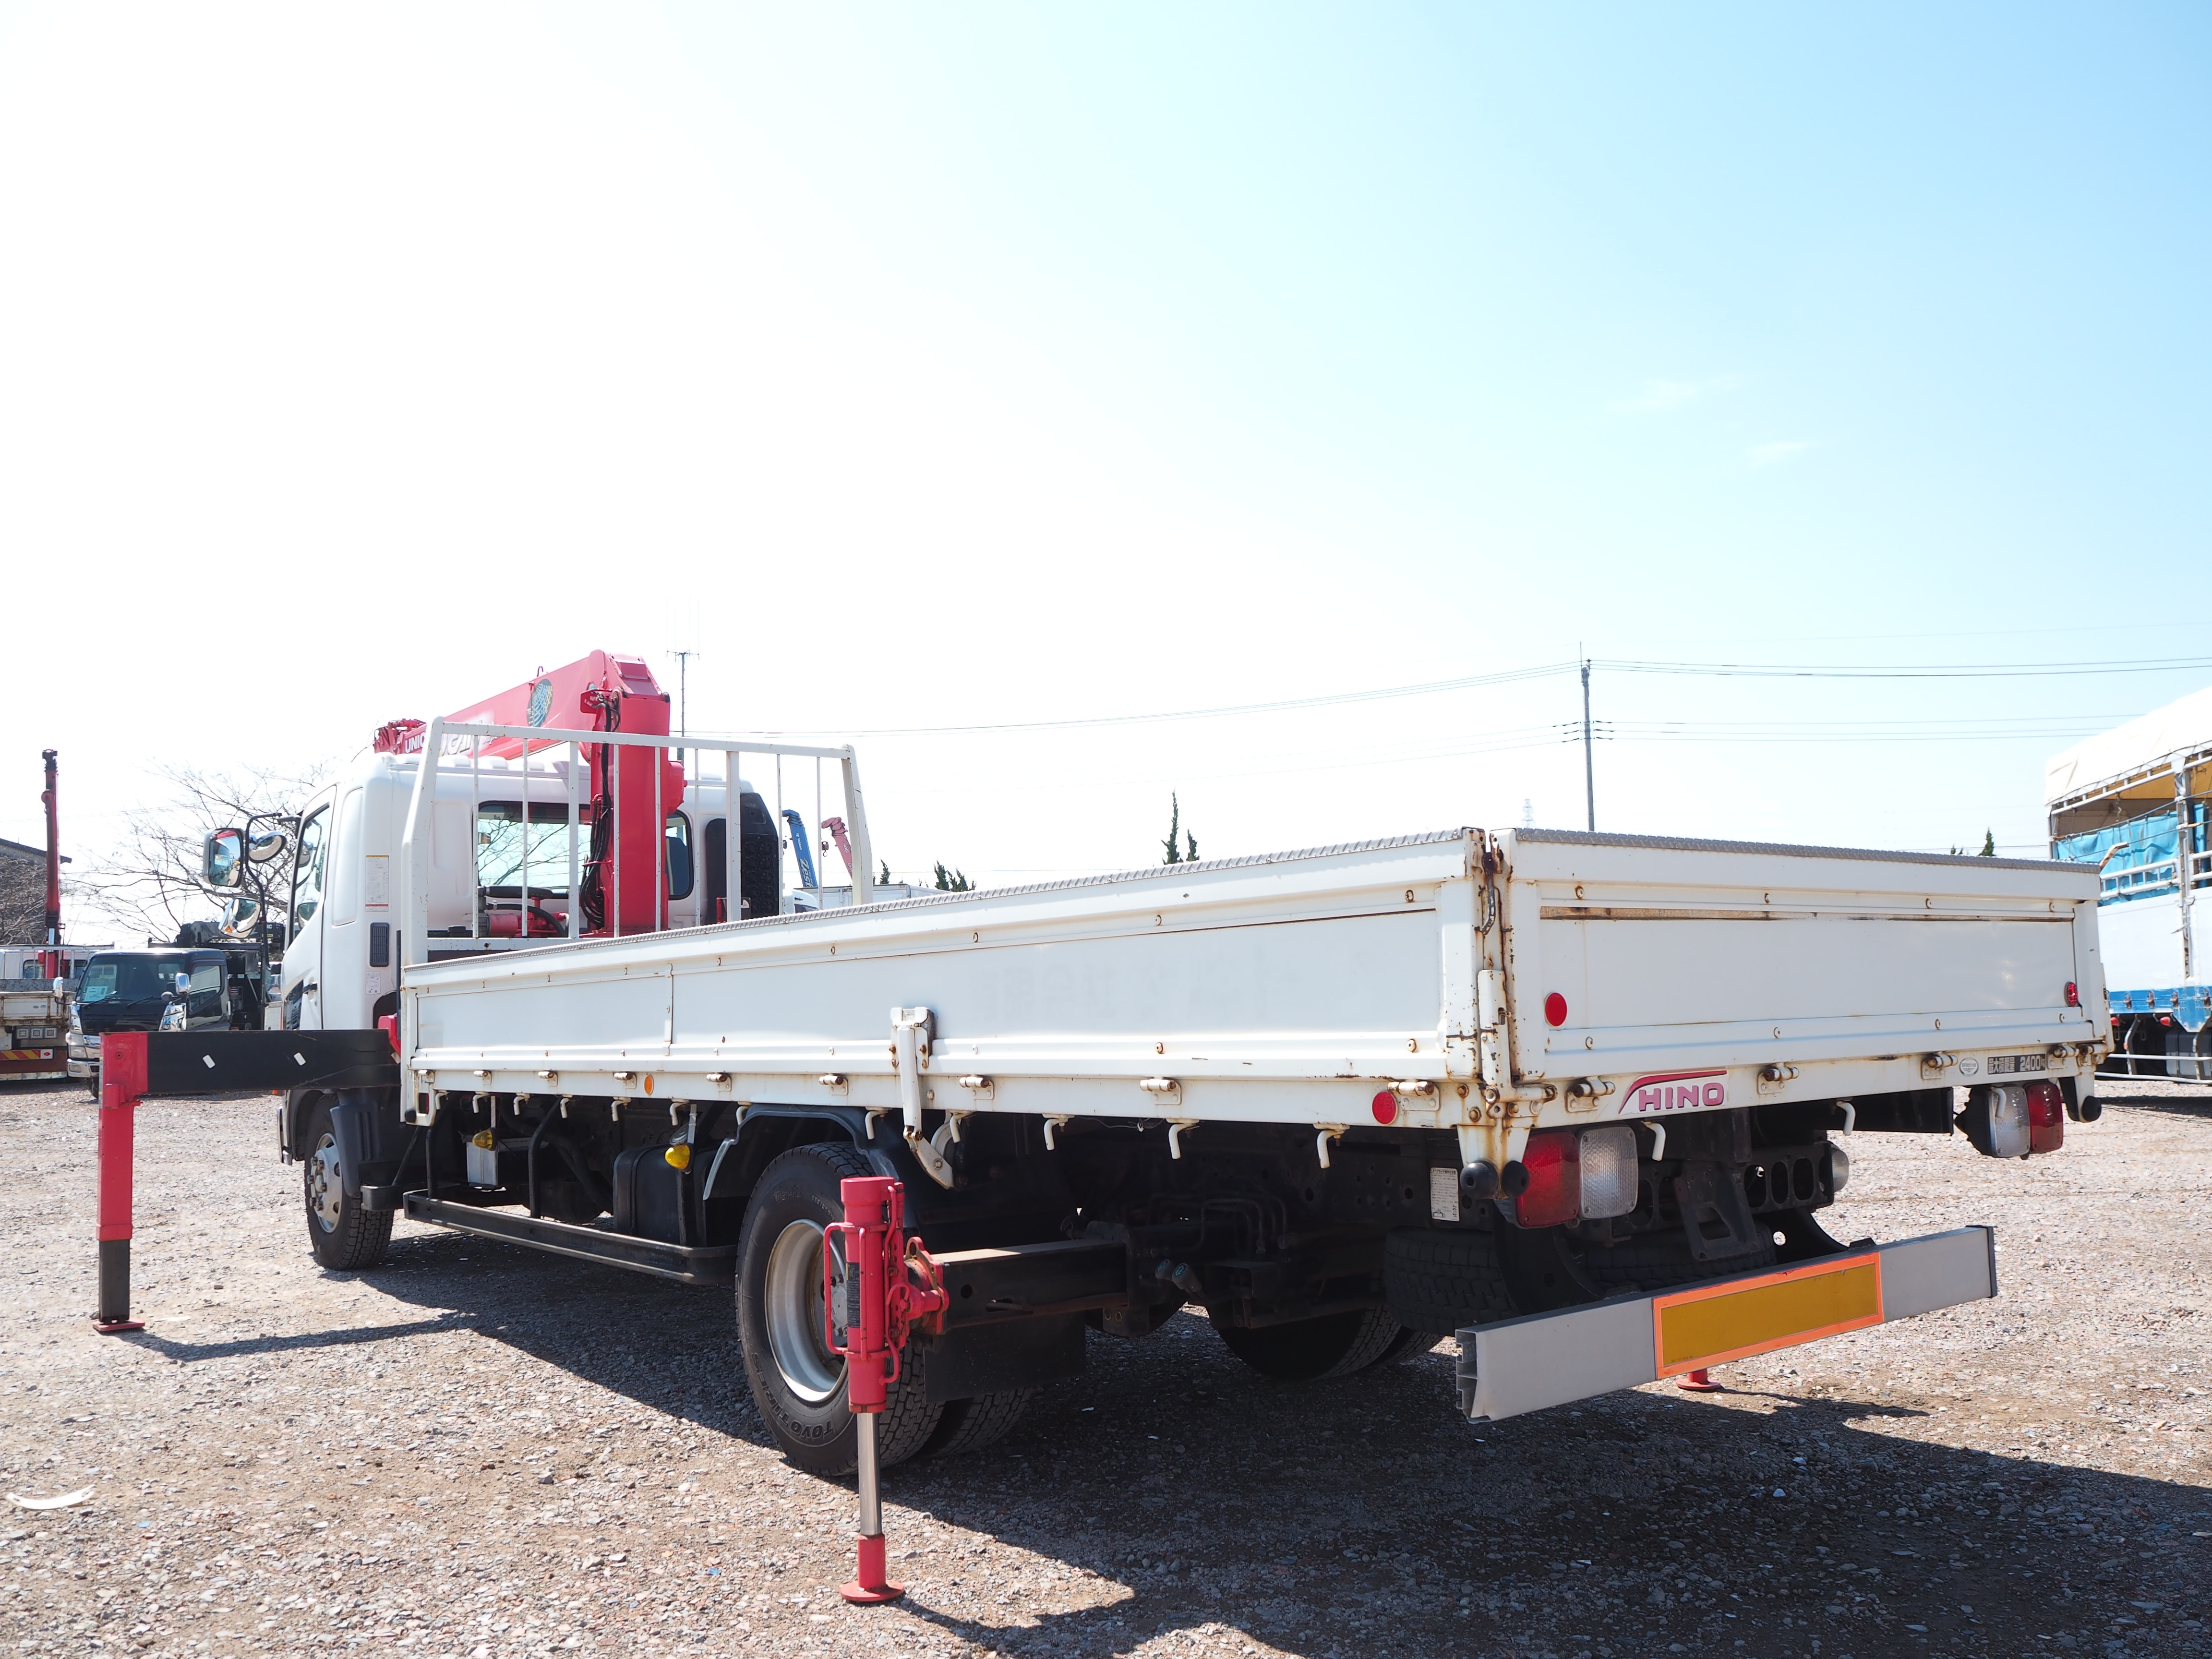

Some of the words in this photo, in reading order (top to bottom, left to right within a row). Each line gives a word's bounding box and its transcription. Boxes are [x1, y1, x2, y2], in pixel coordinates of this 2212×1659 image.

[1639, 1082, 1724, 1112] HINO
[751, 1352, 790, 1426] TIRES
[790, 1419, 834, 1439] TOYO
